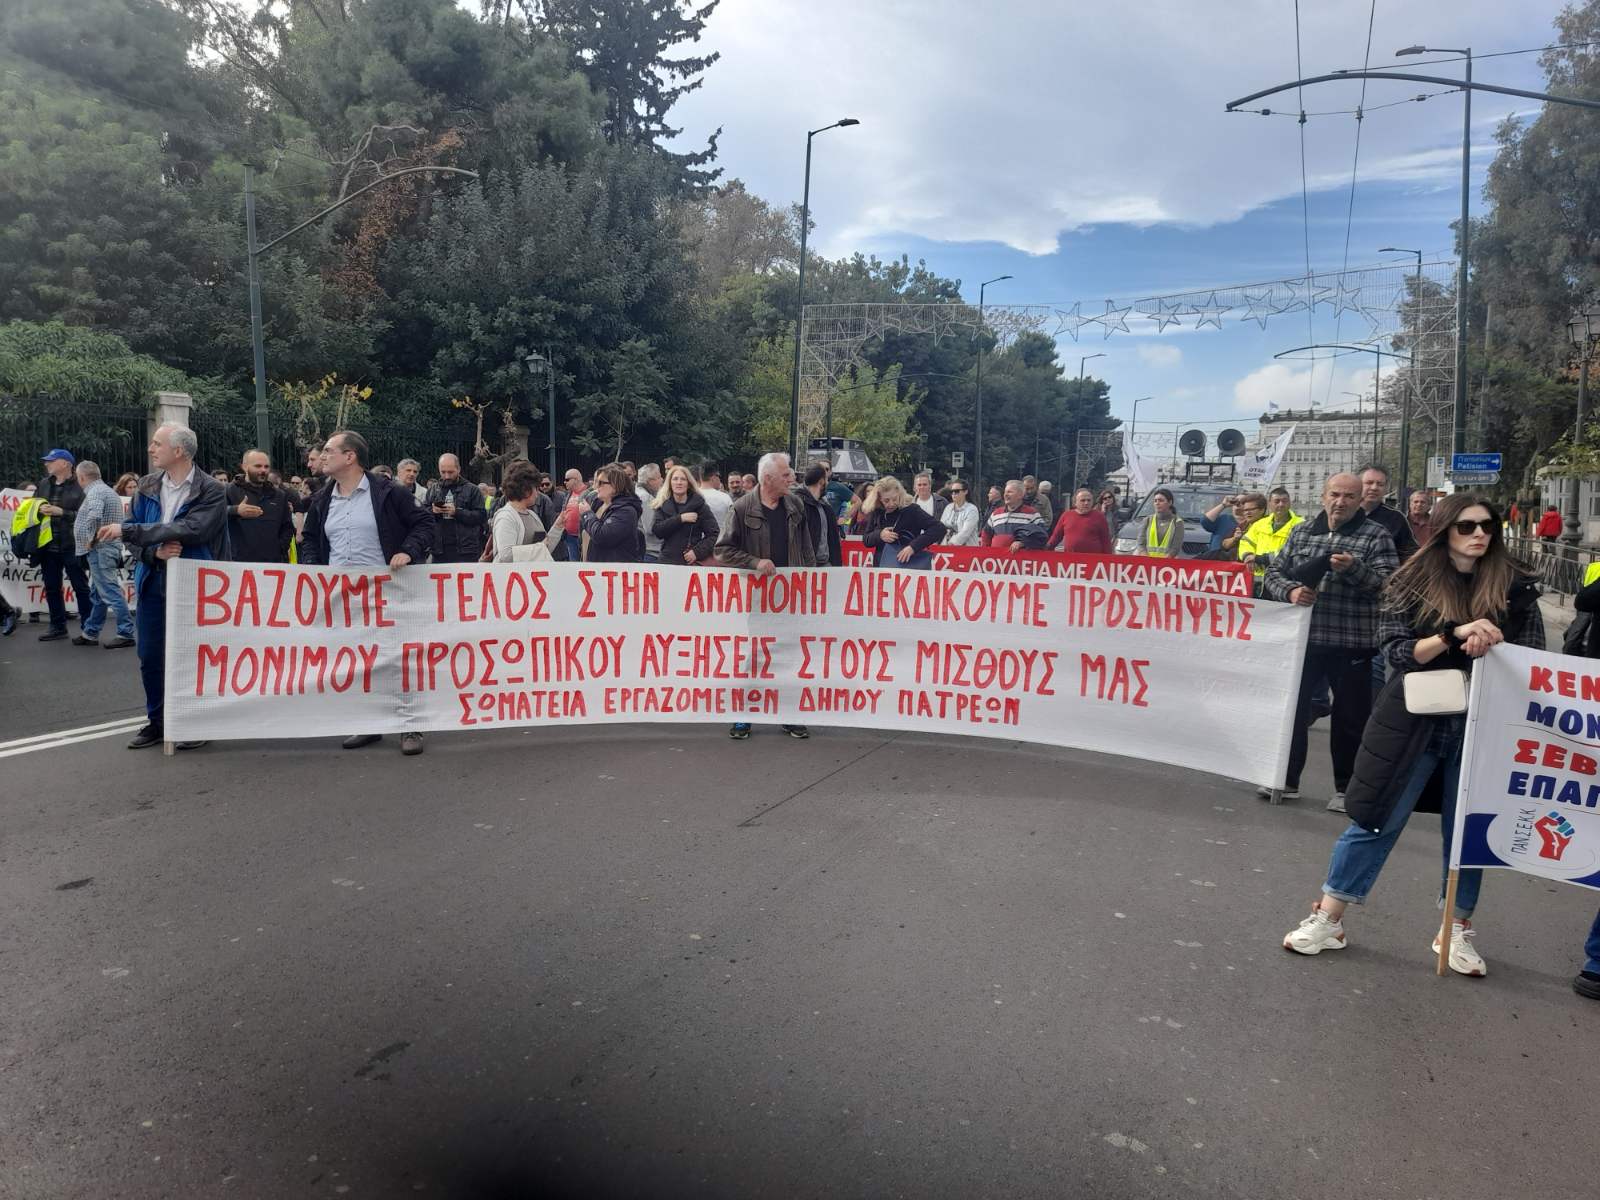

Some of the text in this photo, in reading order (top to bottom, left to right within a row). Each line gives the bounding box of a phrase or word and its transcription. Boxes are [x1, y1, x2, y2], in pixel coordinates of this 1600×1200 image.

[196, 567, 395, 628] ΒΑΖΟΥΜΕ
[430, 571, 550, 624] ΤΕΛΟΣ
[577, 570, 660, 618] ΣΤΗΝ
[684, 570, 828, 616] ΑΝΑΜΟΝΗ
[844, 571, 1049, 627] ΔΙΕΚΔΙΚΟΥΜΕ
[1068, 584, 1256, 641] ΠΡΟΣΛΗΨΕΙΣ
[1057, 562, 1087, 580] ΜΕ
[1091, 561, 1248, 596] ΔΙΚΑΙΩΜΑΤΑ
[196, 633, 1150, 707] ΜΟΝΙΜΟΥ ΠΡΟΣΩΠΙΚΟΥ ΑΥΞΗΣΕΙΣ ΣΤΟΥΣ ΜΙΣΘΟΥΣ ΜΑΣ
[459, 686, 1021, 726] ΣΩΜΑΤΕΙΑ ΕΡΓΑΖΟΜΕΝΩΝ ΔΗΜΟΥ ΠΑΤΡΕΩΝ
